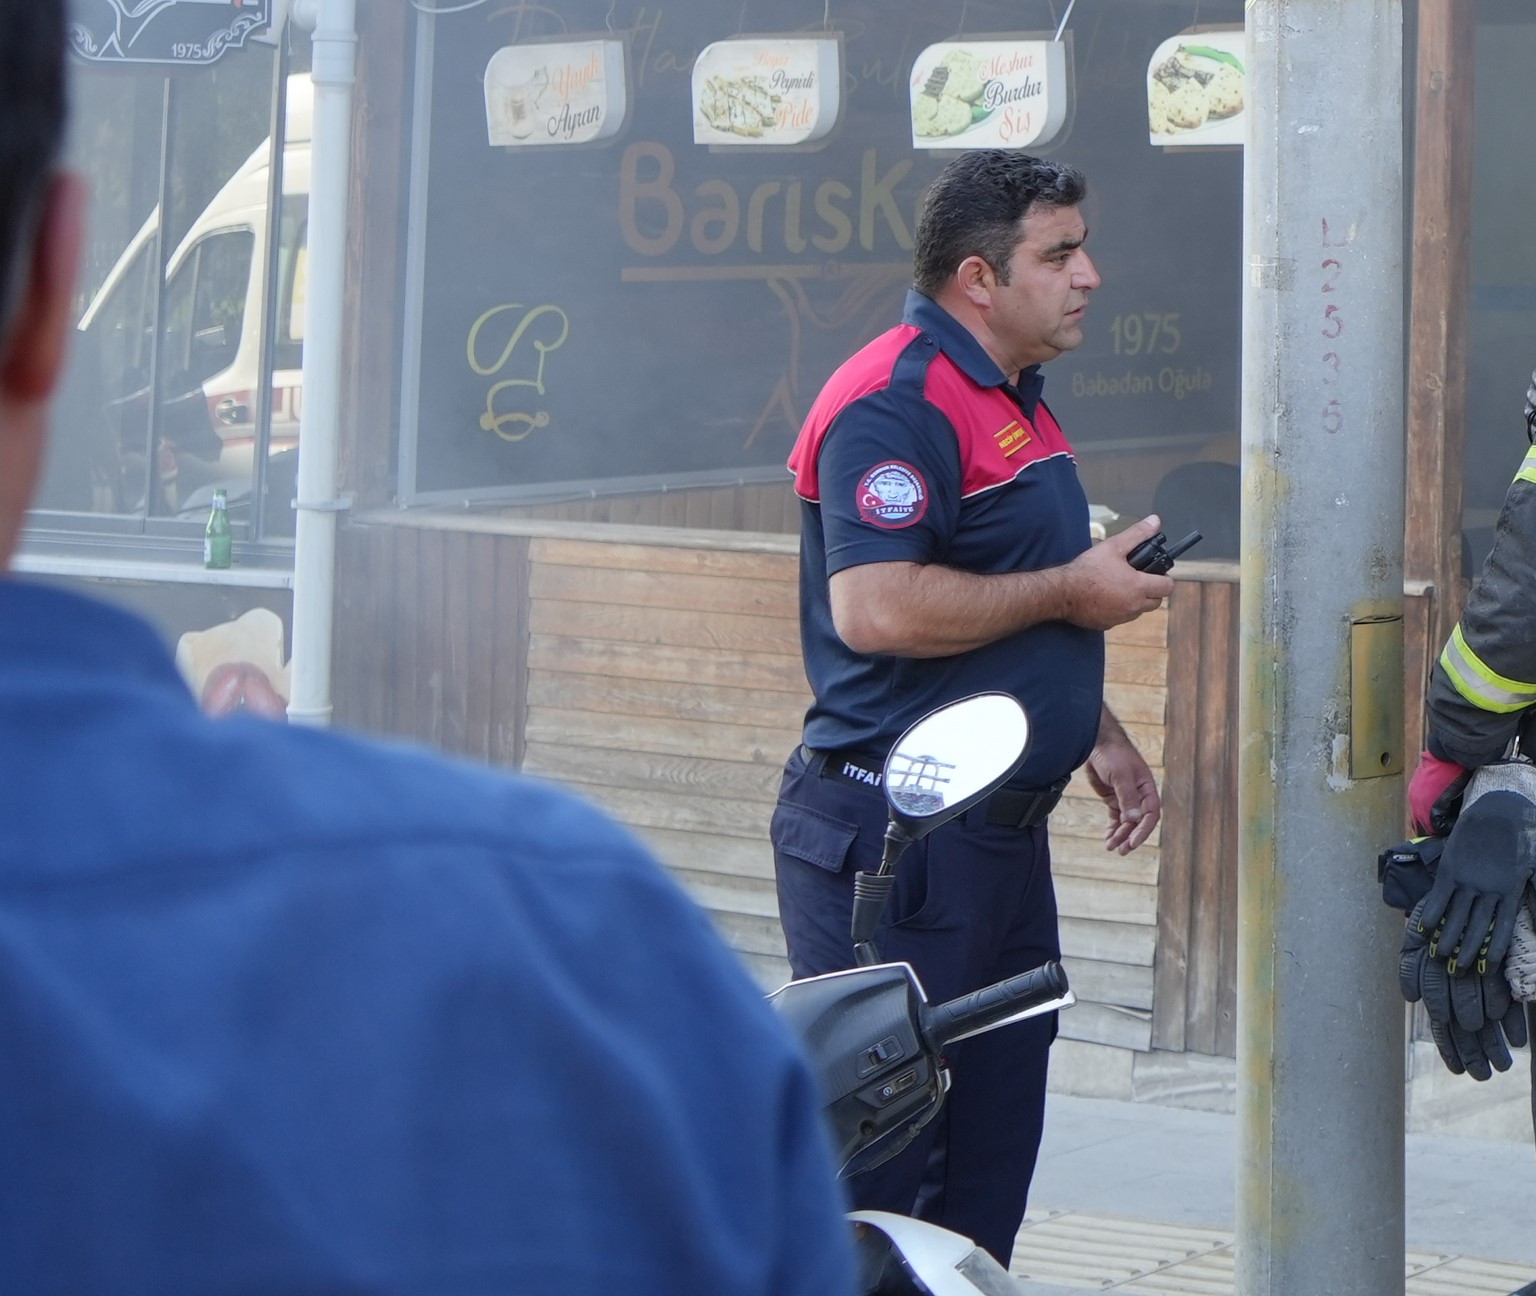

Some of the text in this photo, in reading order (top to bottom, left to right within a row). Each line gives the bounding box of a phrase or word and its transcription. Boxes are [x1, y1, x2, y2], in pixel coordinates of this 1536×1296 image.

[171, 42, 201, 58] 1975
[984, 76, 1042, 109] Burdur
[547, 103, 600, 140] Ayran
[773, 98, 813, 132] Pide
[1110, 312, 1182, 355] 1975
[1072, 367, 1213, 400] Babadan Oğula
